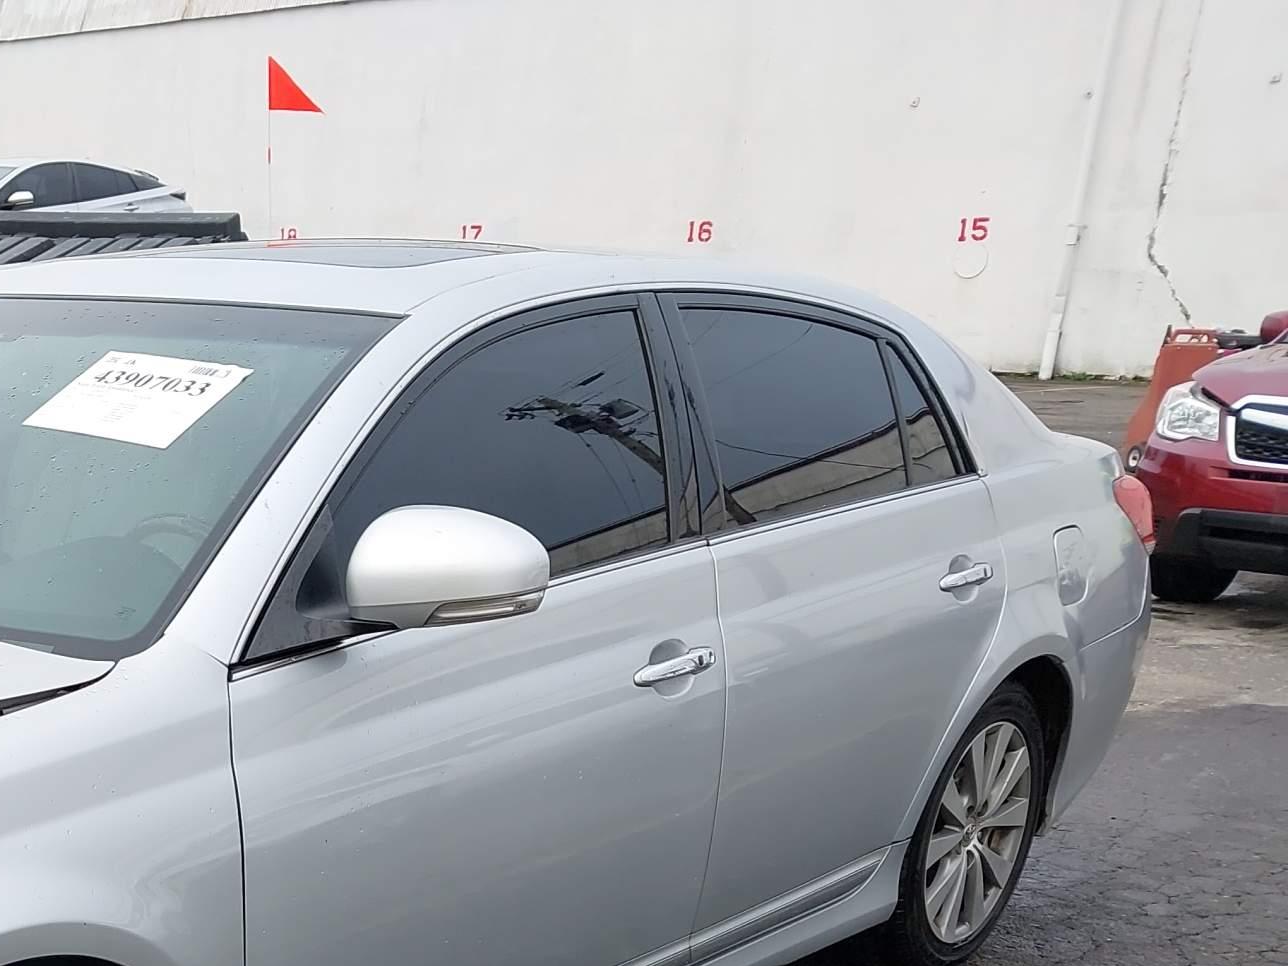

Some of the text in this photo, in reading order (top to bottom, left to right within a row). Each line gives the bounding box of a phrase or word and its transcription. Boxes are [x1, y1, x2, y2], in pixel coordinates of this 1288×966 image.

[462, 225, 483, 240] 17
[687, 220, 713, 243] 16
[957, 217, 990, 242] 15
[94, 369, 211, 396] 43907033
